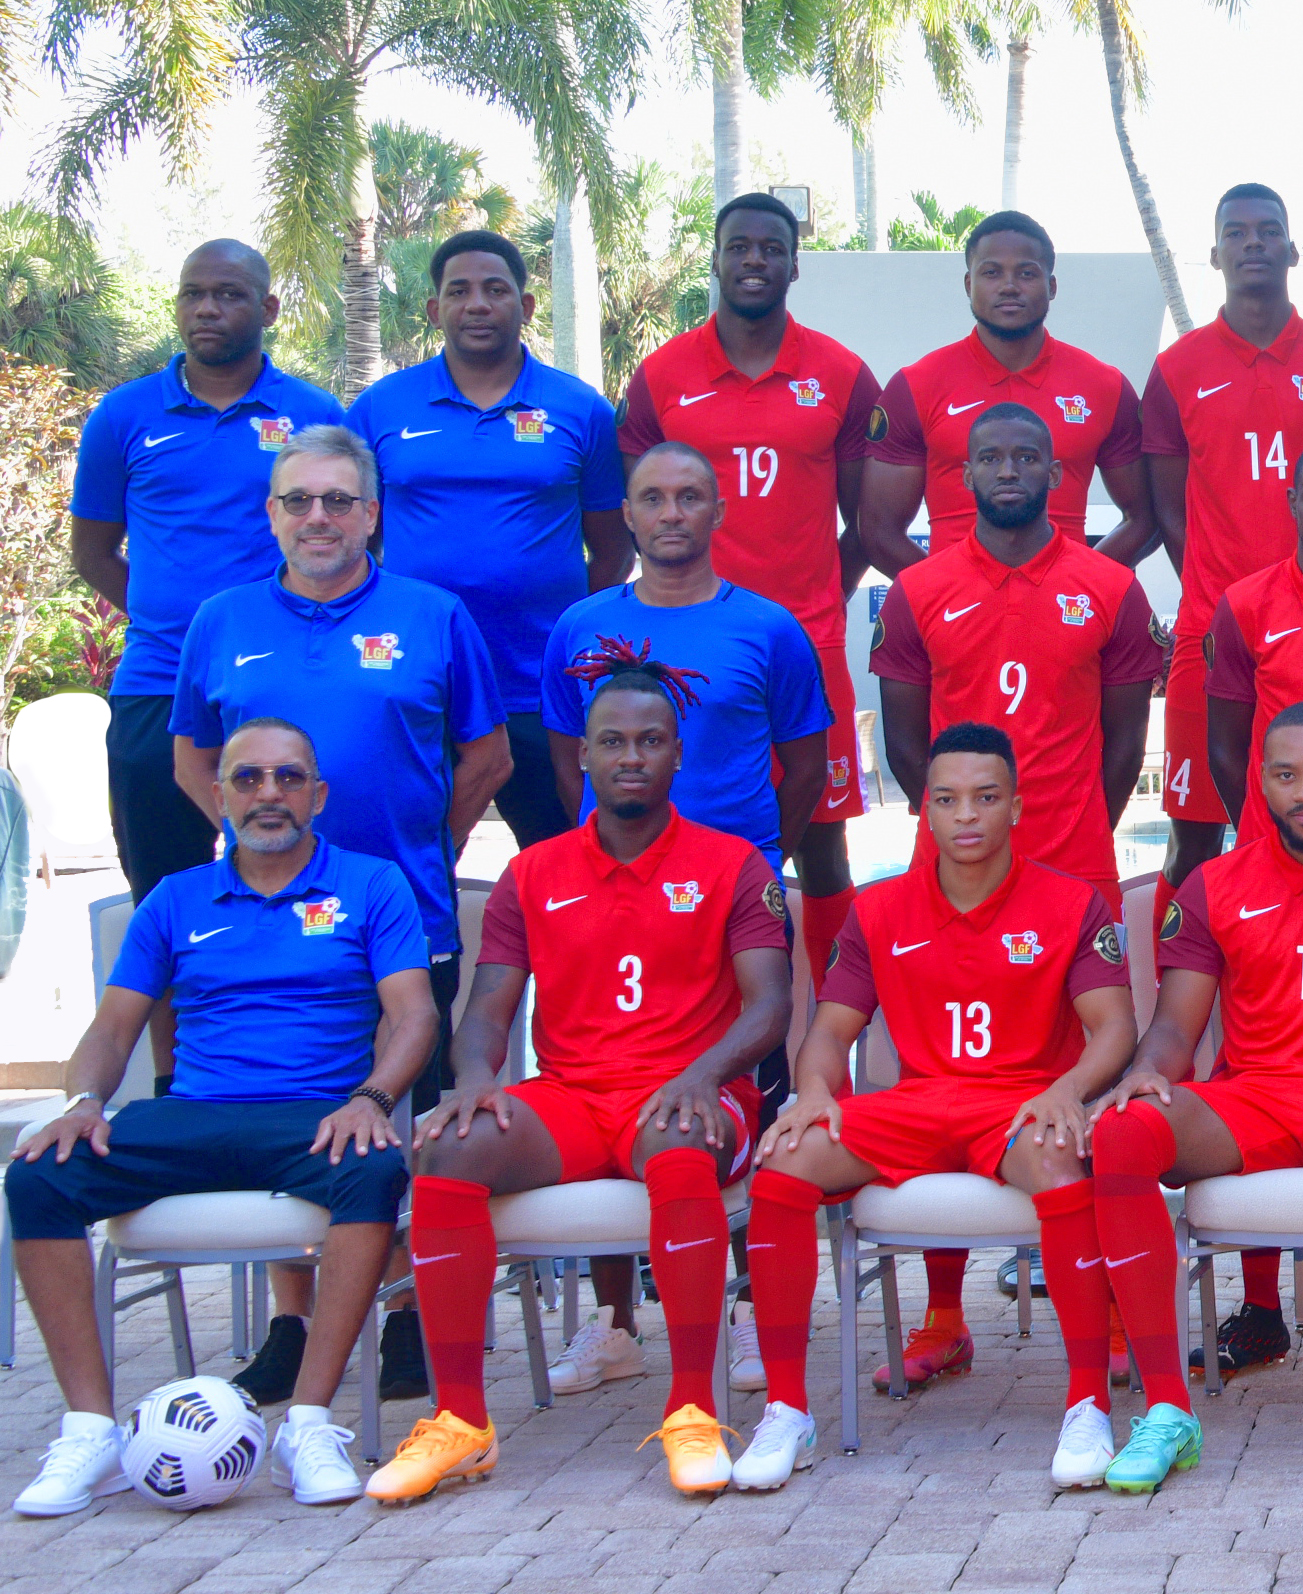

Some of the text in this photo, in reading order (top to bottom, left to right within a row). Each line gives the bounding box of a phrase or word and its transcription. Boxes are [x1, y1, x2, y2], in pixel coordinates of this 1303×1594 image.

[800, 389, 814, 398] LGF
[1066, 406, 1081, 415] LGF
[518, 422, 541, 433] LGF
[262, 429, 286, 442] LGF
[1244, 430, 1288, 481] 14
[733, 446, 779, 497] 19
[1066, 606, 1083, 615] LGF
[365, 648, 389, 660] LGF
[999, 661, 1027, 715] 9
[674, 894, 692, 904] LGF
[306, 913, 330, 926] LGF
[1012, 945, 1030, 954] LGF
[616, 954, 643, 1012] 3
[945, 1001, 991, 1058] 13
